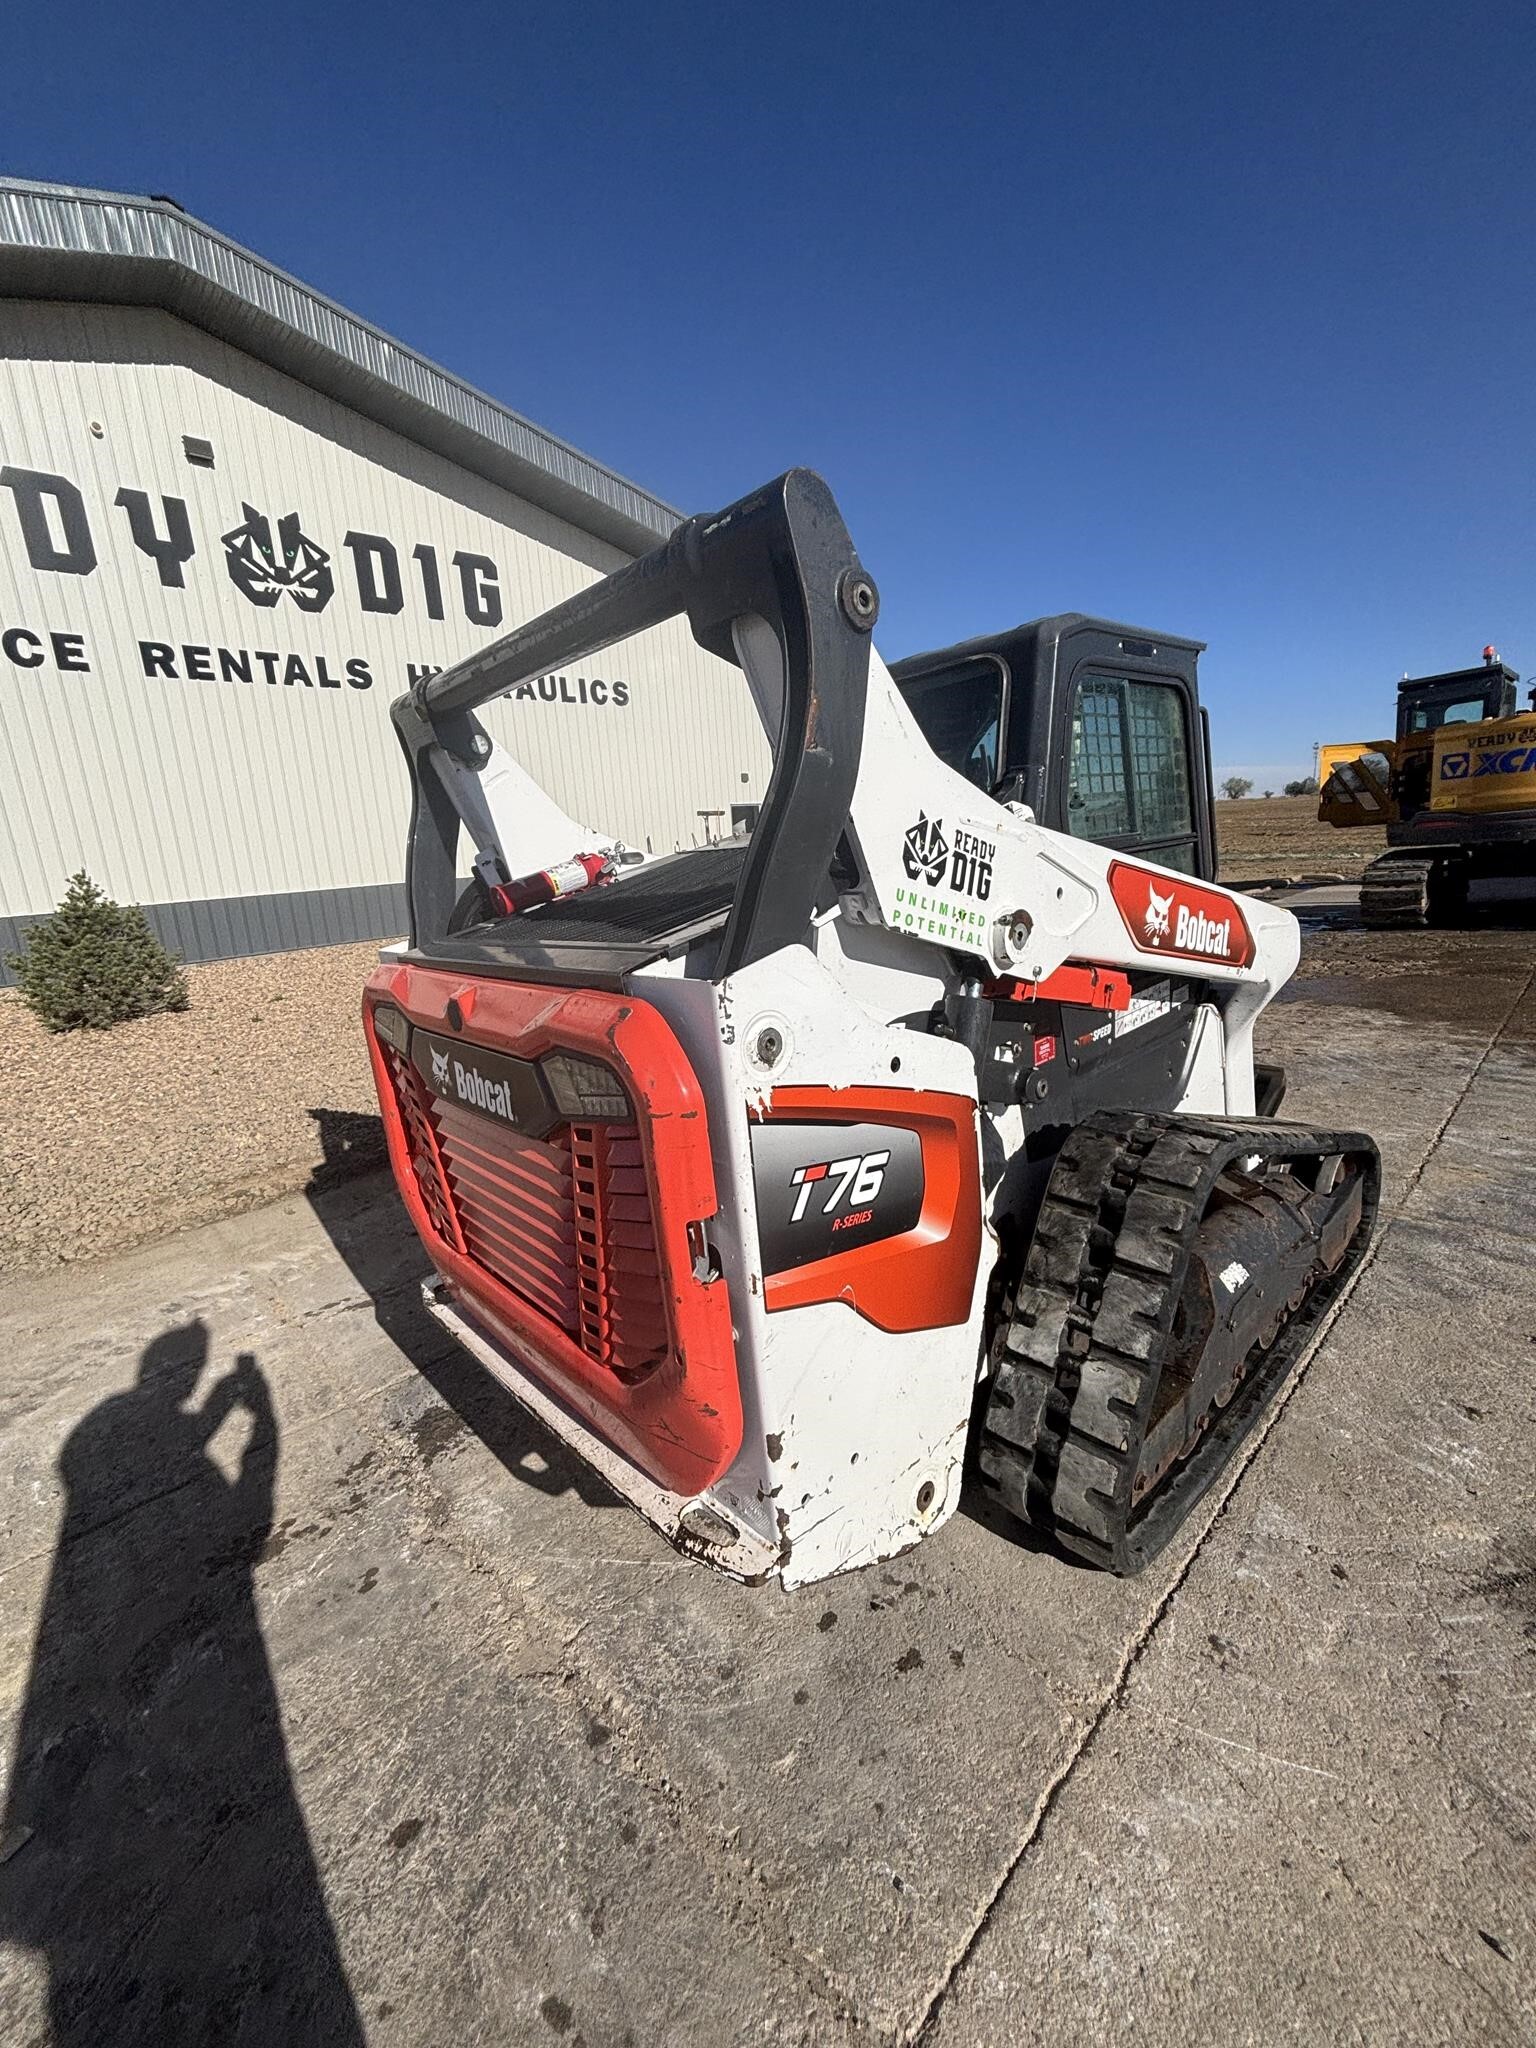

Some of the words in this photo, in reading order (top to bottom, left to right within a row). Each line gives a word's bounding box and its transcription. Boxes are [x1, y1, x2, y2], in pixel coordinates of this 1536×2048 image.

[344, 530, 502, 627] DIG
[1, 628, 91, 673] CE
[138, 641, 373, 690] RENTALS
[406, 663, 630, 707] HAULICS
[954, 828, 996, 863] READY
[949, 850, 993, 901] DIG
[892, 909, 983, 947] POTENTIAL
[1175, 904, 1230, 957] Bobcat
[453, 1060, 515, 1122] Bobcat
[788, 1149, 891, 1225] T76
[832, 1209, 873, 1232] R-SERIES
